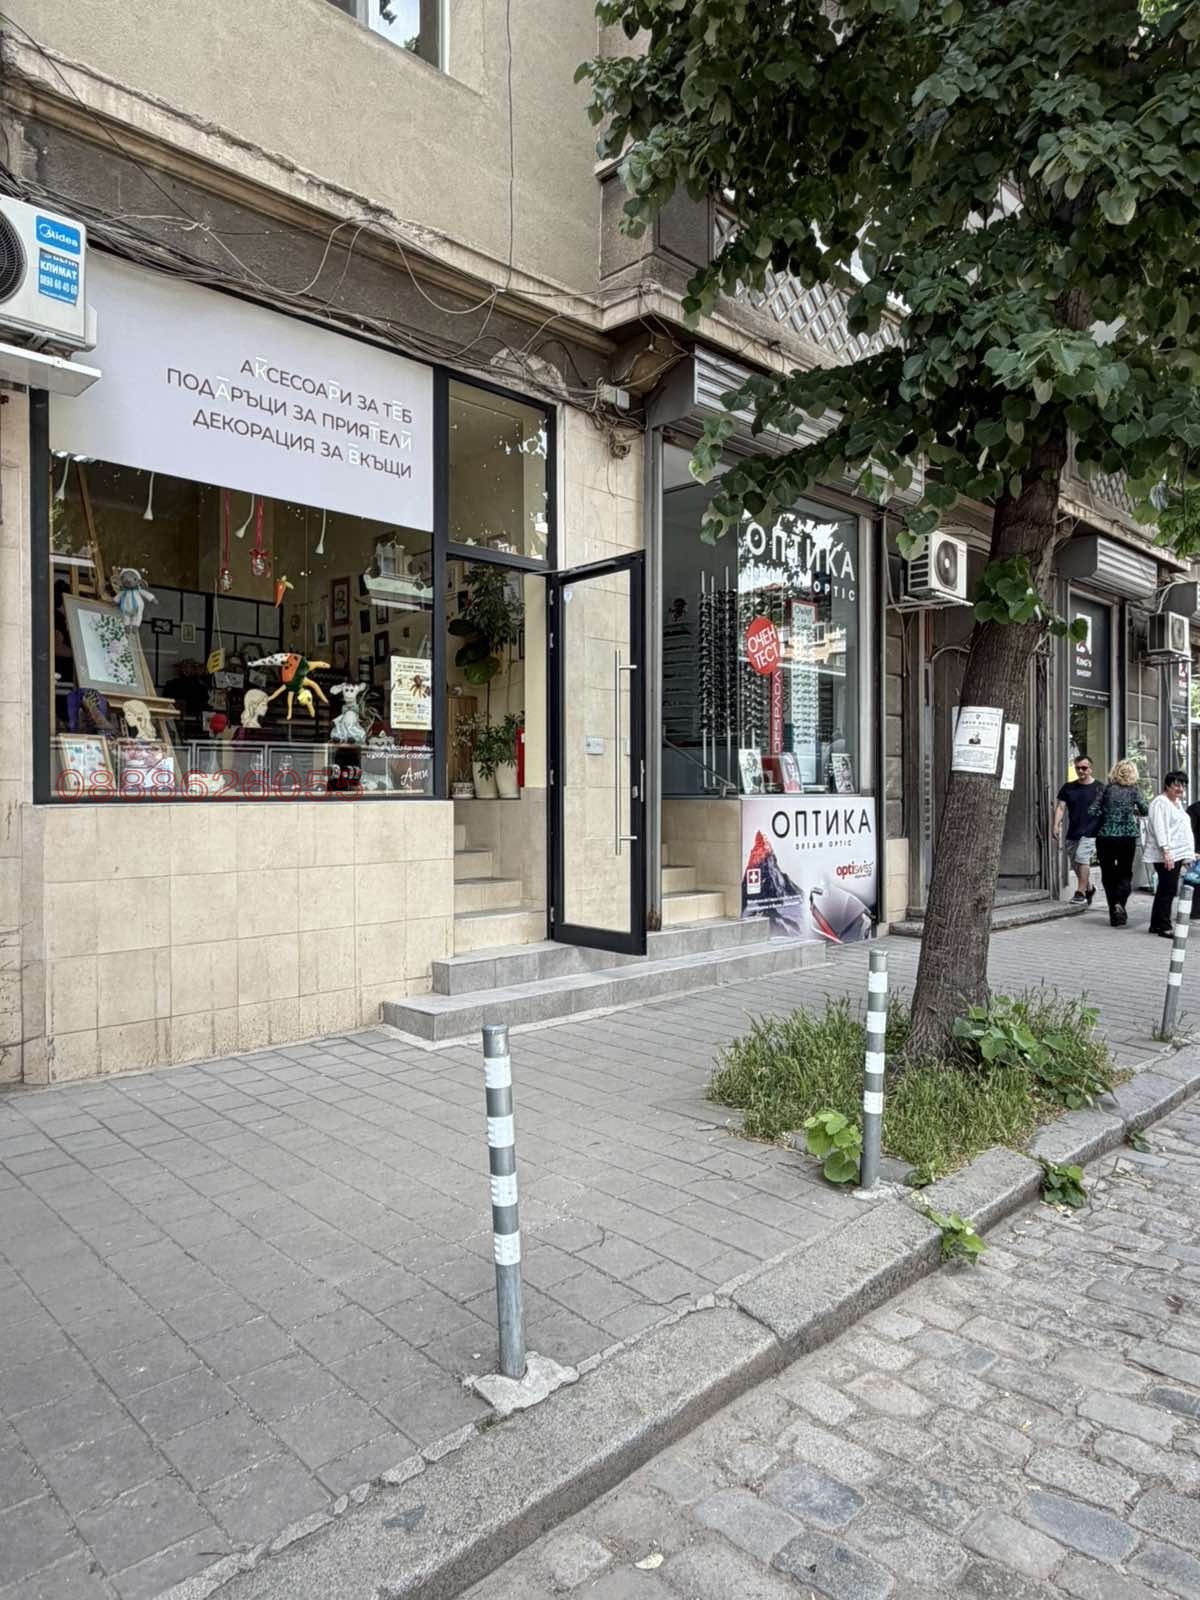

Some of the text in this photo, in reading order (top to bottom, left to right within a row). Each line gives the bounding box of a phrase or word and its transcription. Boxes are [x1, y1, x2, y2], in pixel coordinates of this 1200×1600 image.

[39, 224, 78, 248] Midea
[40, 260, 78, 280] КЛИМАТ
[240, 357, 413, 425] АКСЕСОАРИ ЗА ТЕБ
[168, 368, 412, 453] ПОДАРЪЦИ ЗА ПРИЯТЕЛИ
[193, 408, 411, 479] ДЕКОРАЦИЯ ЗА ВКЪЩИ
[746, 521, 855, 582] ОПТИКА
[813, 581, 855, 601] OPTIC
[747, 624, 777, 654] ОЧЕН
[754, 641, 779, 669] ТЕСТ
[55, 769, 364, 801] 0888626055
[771, 808, 872, 839] ОПТИКА
